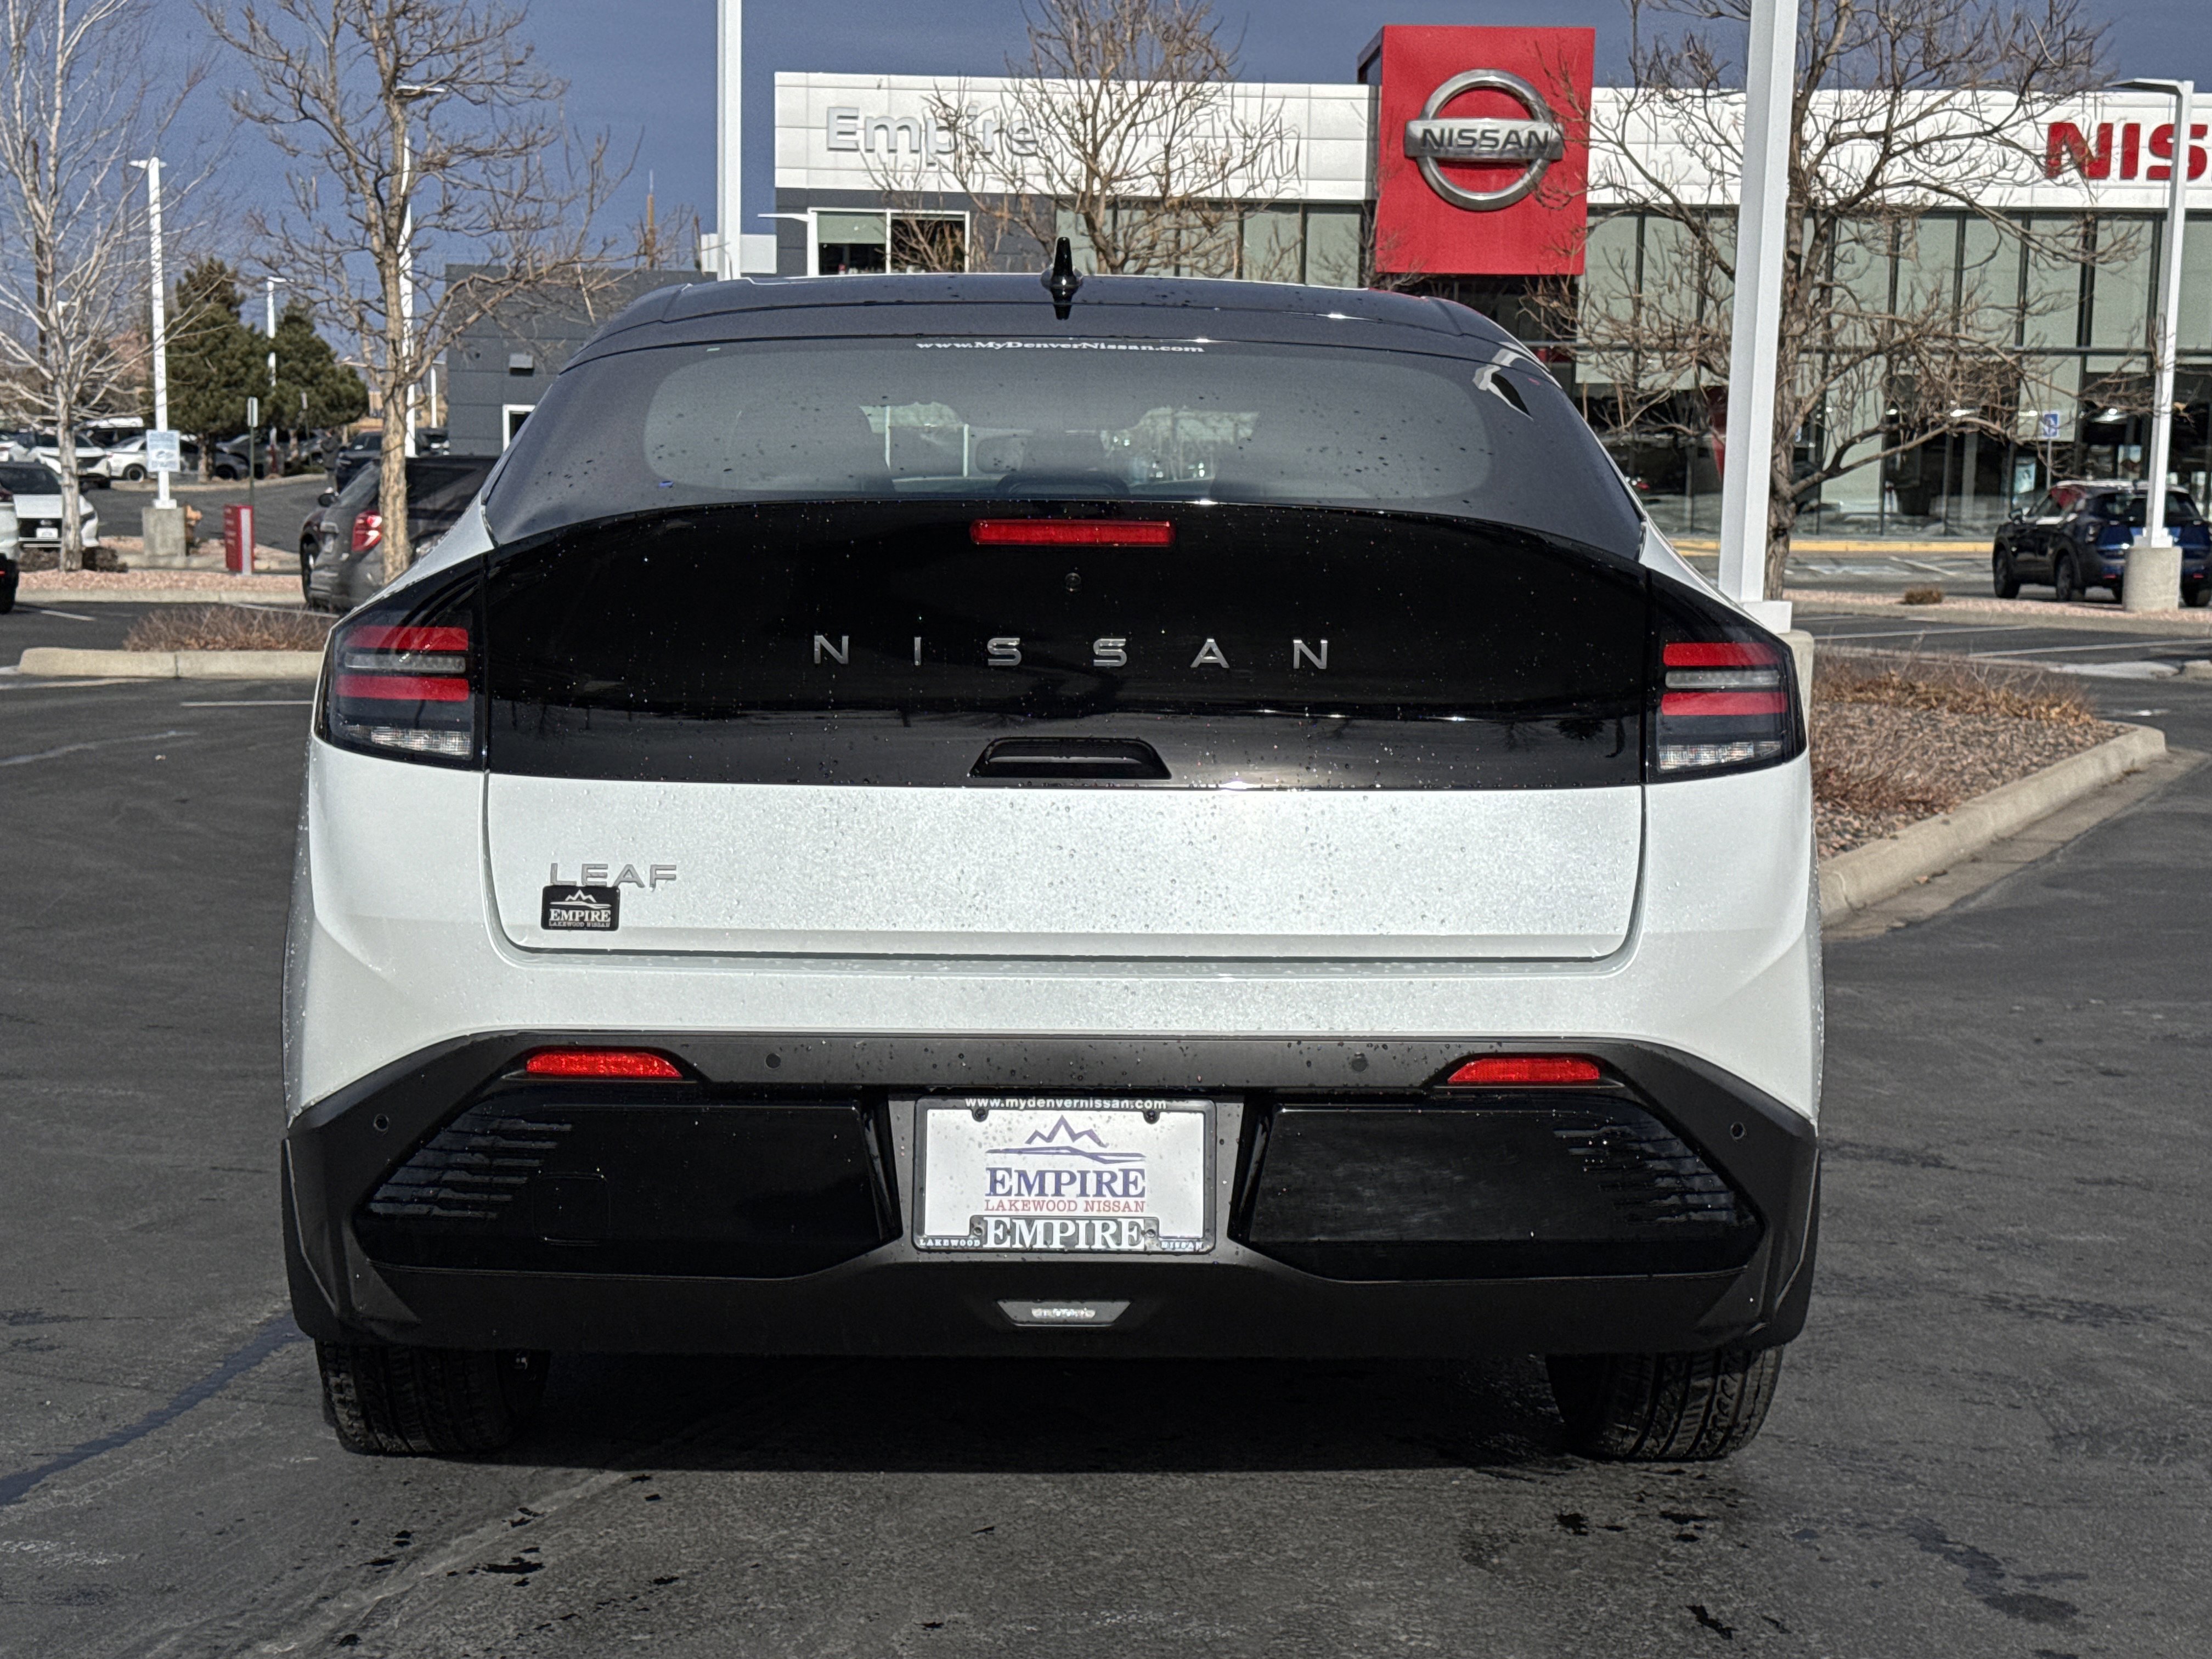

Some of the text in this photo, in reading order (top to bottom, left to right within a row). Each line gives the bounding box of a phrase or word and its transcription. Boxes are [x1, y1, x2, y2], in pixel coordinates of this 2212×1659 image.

[1420, 128, 1549, 151] NISSAN
[916, 341, 1205, 352] www.MyDenverNissan.com
[814, 635, 1328, 669] NISSAN
[550, 862, 677, 890] LEAF
[549, 909, 611, 922] EMPIRE
[965, 1097, 1167, 1109] www.mydenvernissan.com
[985, 1167, 1146, 1198] EMPIRE
[984, 1199, 1146, 1213] LAKEWOOD NISSAN
[919, 1238, 981, 1247] LAKEWOOD
[983, 1216, 1145, 1250] EMPIRE
